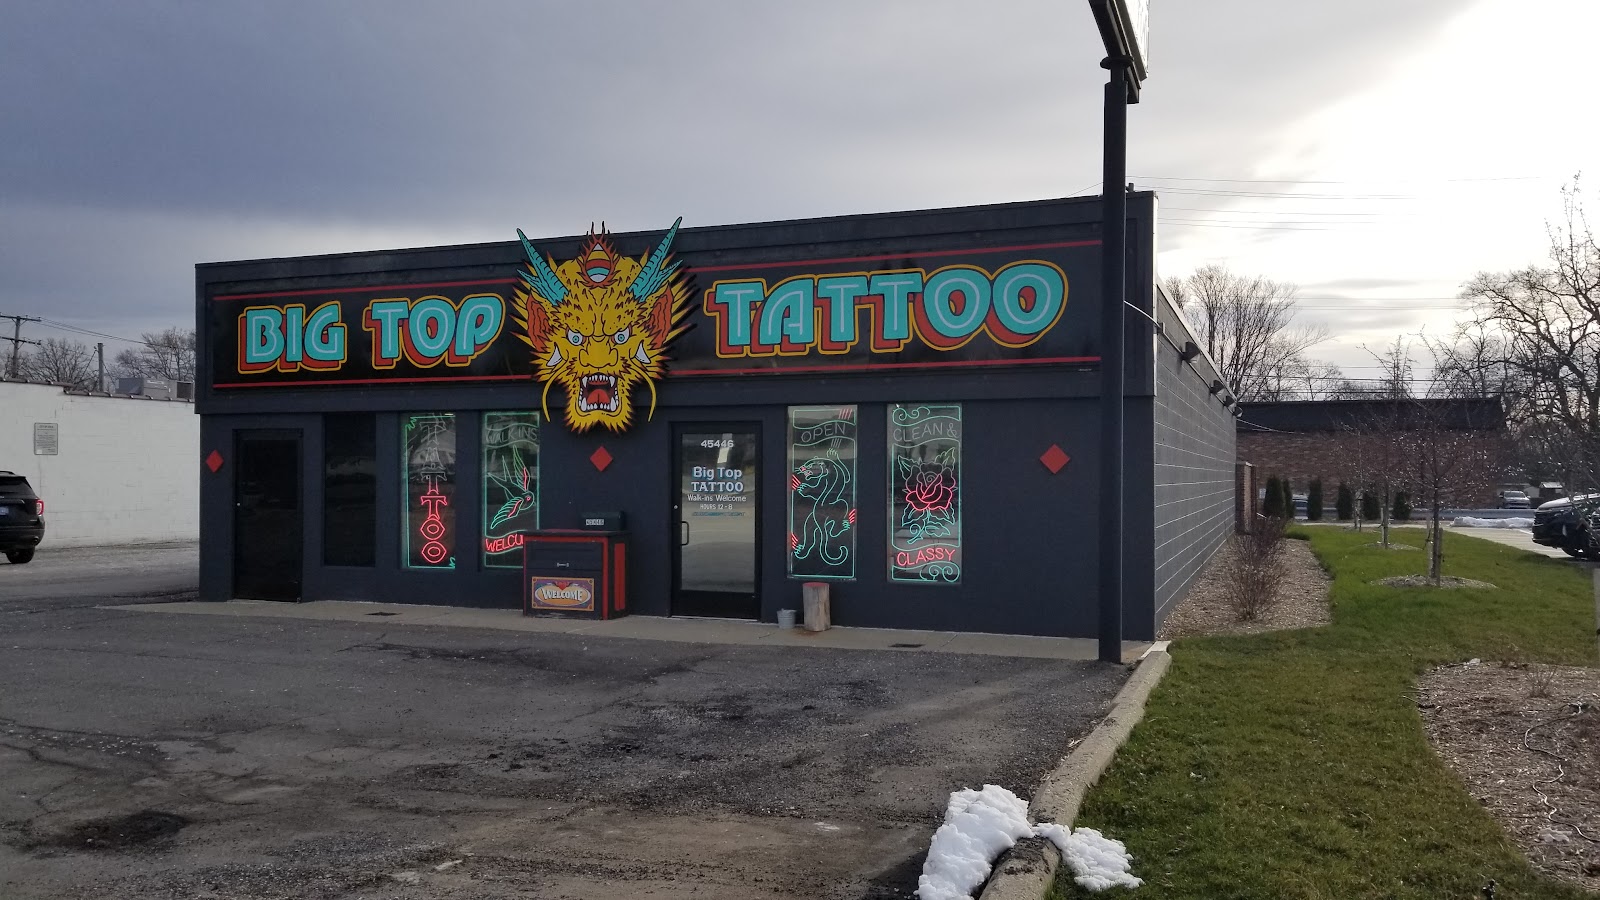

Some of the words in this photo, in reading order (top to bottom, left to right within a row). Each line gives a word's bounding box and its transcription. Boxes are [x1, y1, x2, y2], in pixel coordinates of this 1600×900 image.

[238, 301, 347, 374] BIG
[363, 292, 505, 370] TOP
[704, 259, 1068, 358] TATTOO
[801, 423, 846, 443] OPEN
[893, 422, 943, 443] CLEAN
[947, 422, 960, 438] &
[700, 439, 734, 448] 45446
[692, 466, 715, 480] Big
[717, 467, 742, 480] Top
[419, 421, 448, 563] TATTOO
[691, 481, 744, 492] TATTOO
[687, 494, 713, 502] Walk-ins
[896, 547, 956, 567] CLASSY
[540, 587, 583, 600] WELCOME
